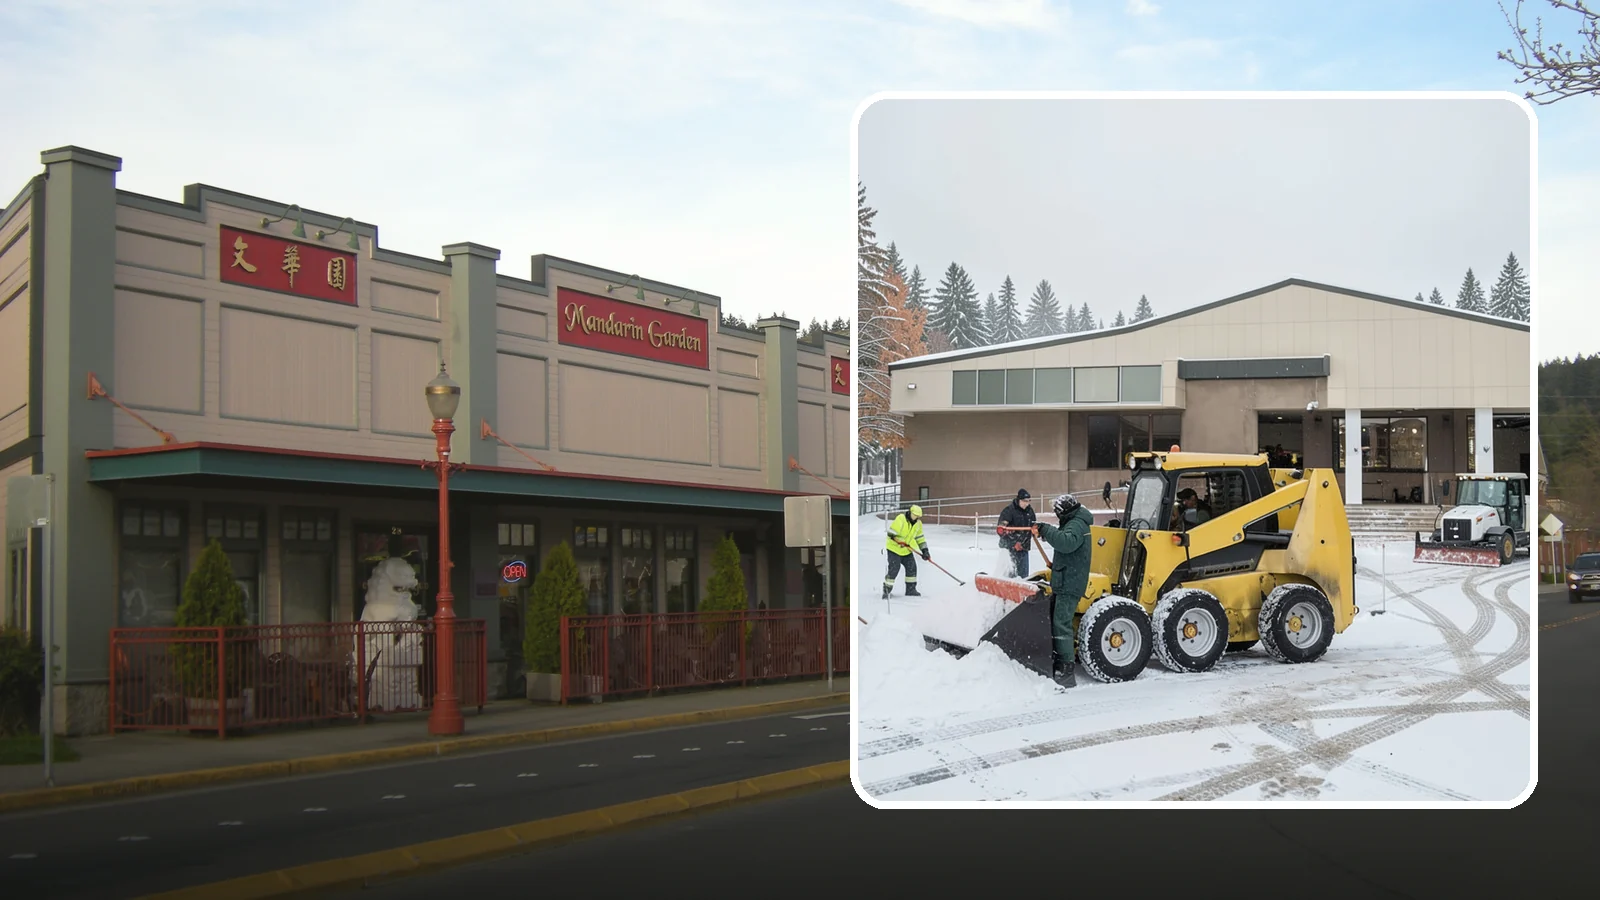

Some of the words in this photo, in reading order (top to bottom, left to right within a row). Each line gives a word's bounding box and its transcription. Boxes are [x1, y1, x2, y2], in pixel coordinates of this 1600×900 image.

[231, 236, 346, 291] 文華園
[565, 302, 644, 341] Mandarin
[648, 320, 701, 352] Garden
[503, 565, 527, 578] OPEN
